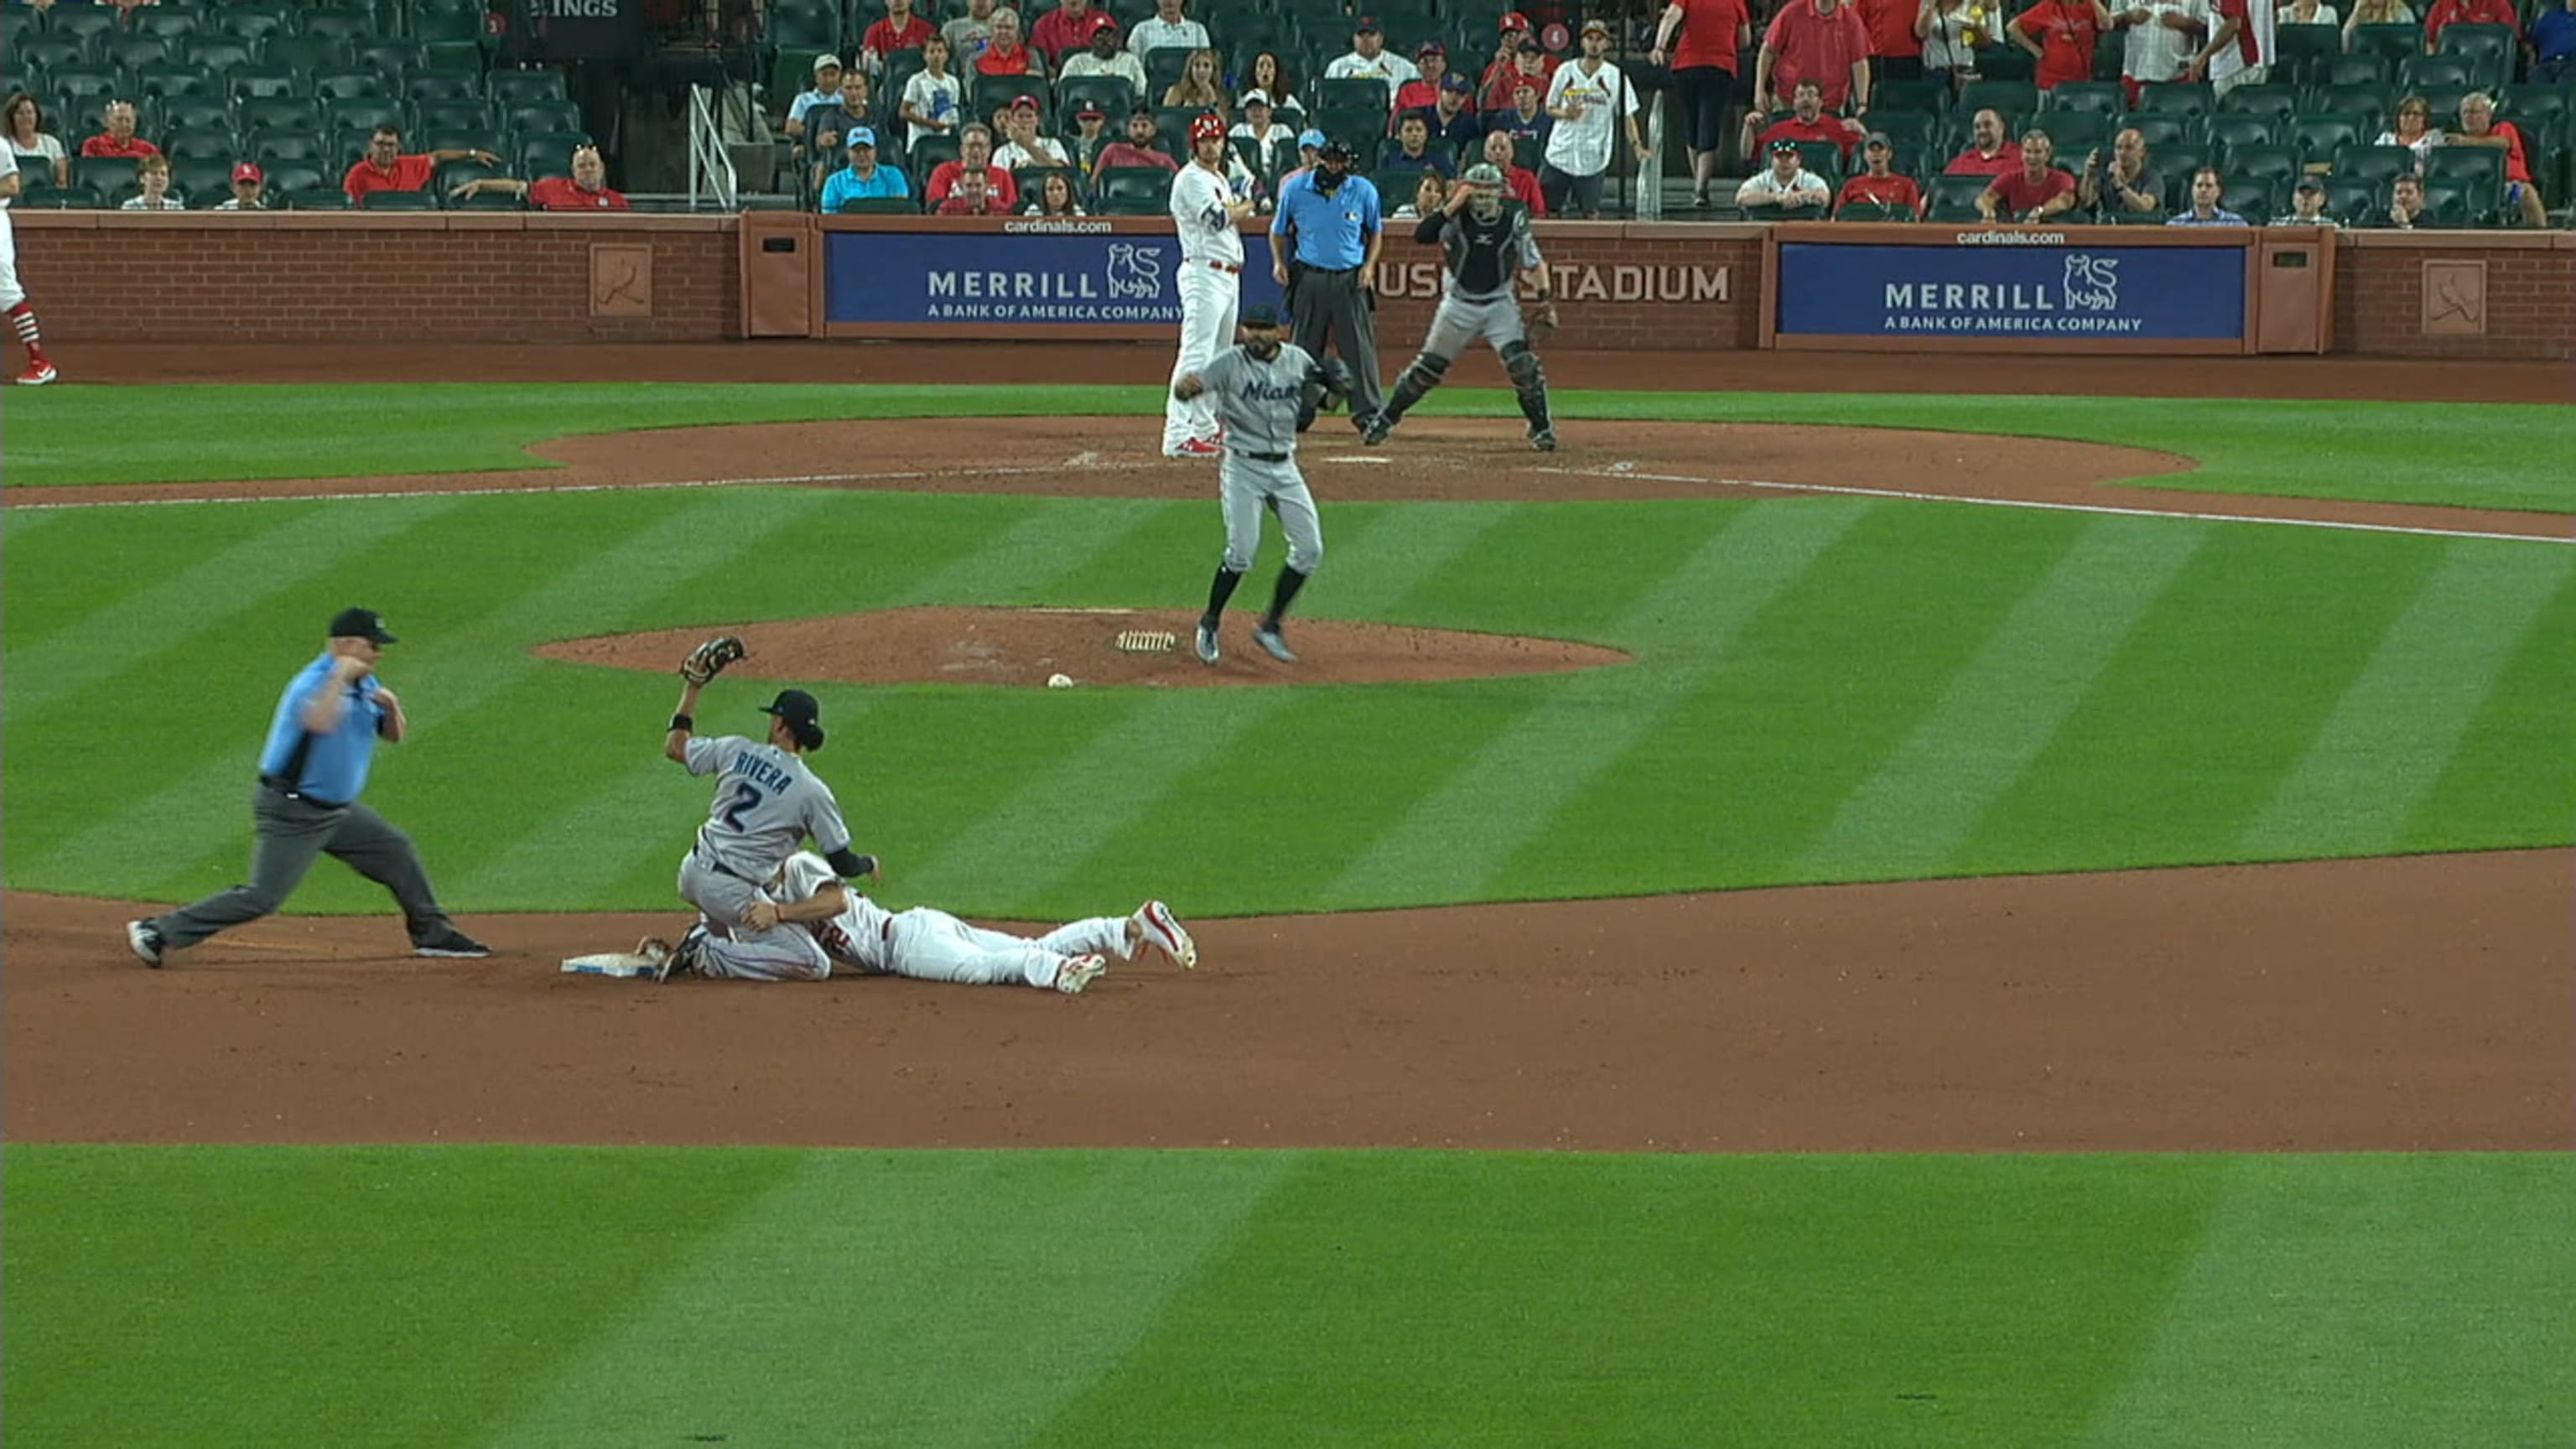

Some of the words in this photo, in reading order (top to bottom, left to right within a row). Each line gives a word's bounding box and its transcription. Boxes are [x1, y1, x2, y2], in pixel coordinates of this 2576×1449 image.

[1005, 220, 1112, 233] cardinals.com
[1957, 231, 2064, 244] cardinals.com
[928, 271, 1098, 298] MERRILL
[1886, 283, 2053, 309] MERRILL
[927, 304, 939, 317] A
[943, 304, 989, 318] BANK
[994, 305, 1016, 318] OF
[1020, 305, 1098, 319] AMERICA
[1885, 316, 1896, 329] A
[1899, 317, 1945, 330] BANK
[1950, 317, 1972, 330] OF
[1976, 317, 2053, 330] AMERICA
[2058, 318, 2142, 331] COMPANY
[734, 752, 792, 796] RIVERA
[725, 782, 762, 833] 2
